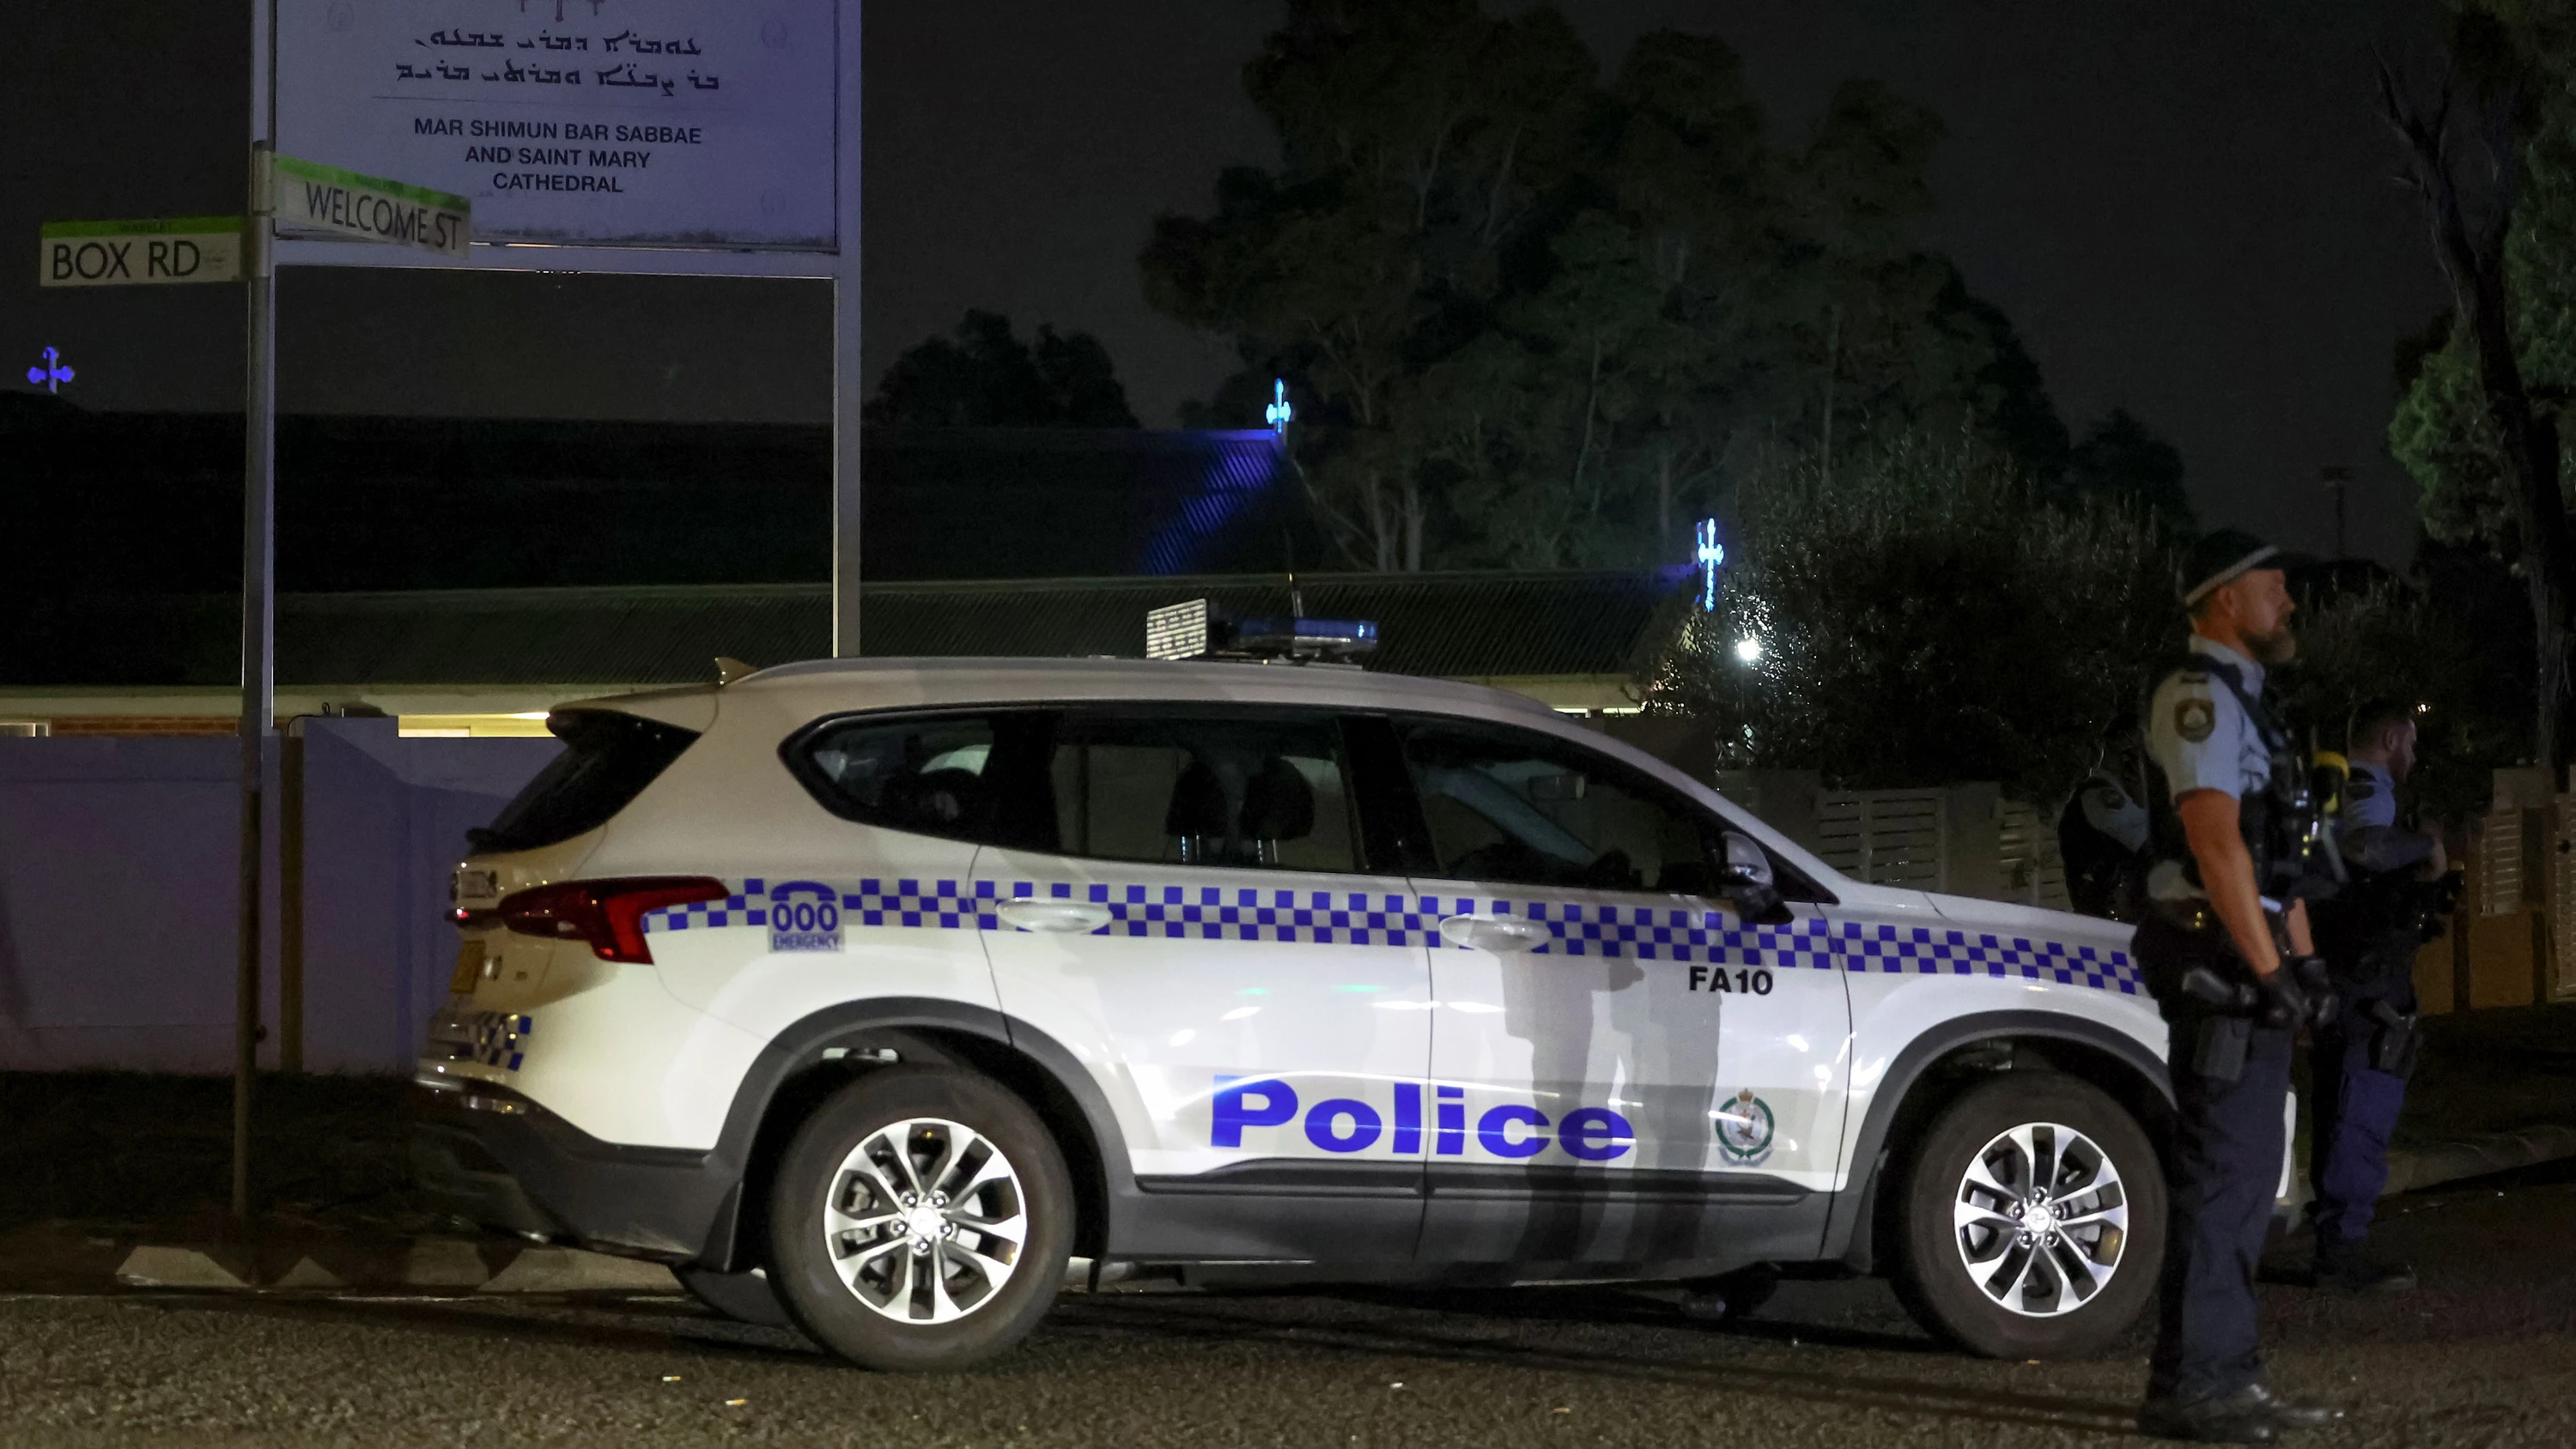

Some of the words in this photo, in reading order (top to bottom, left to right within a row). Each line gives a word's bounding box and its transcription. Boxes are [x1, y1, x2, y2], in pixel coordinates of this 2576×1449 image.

[414, 118, 464, 136] MAR
[471, 119, 557, 139] SHIMUN
[565, 123, 609, 141] BAR
[616, 124, 702, 144] SABBAE
[465, 146, 512, 163] AND
[519, 148, 582, 166] SAINT
[589, 150, 651, 168] MARY
[493, 172, 623, 193] CATHEDRAL
[306, 181, 428, 244] WELCOME
[434, 212, 462, 251] ST
[52, 242, 131, 280] BOX
[148, 239, 201, 277] RD
[773, 902, 838, 931] 000
[1688, 966, 1773, 996] FA10
[1210, 1074, 1634, 1161] Police
